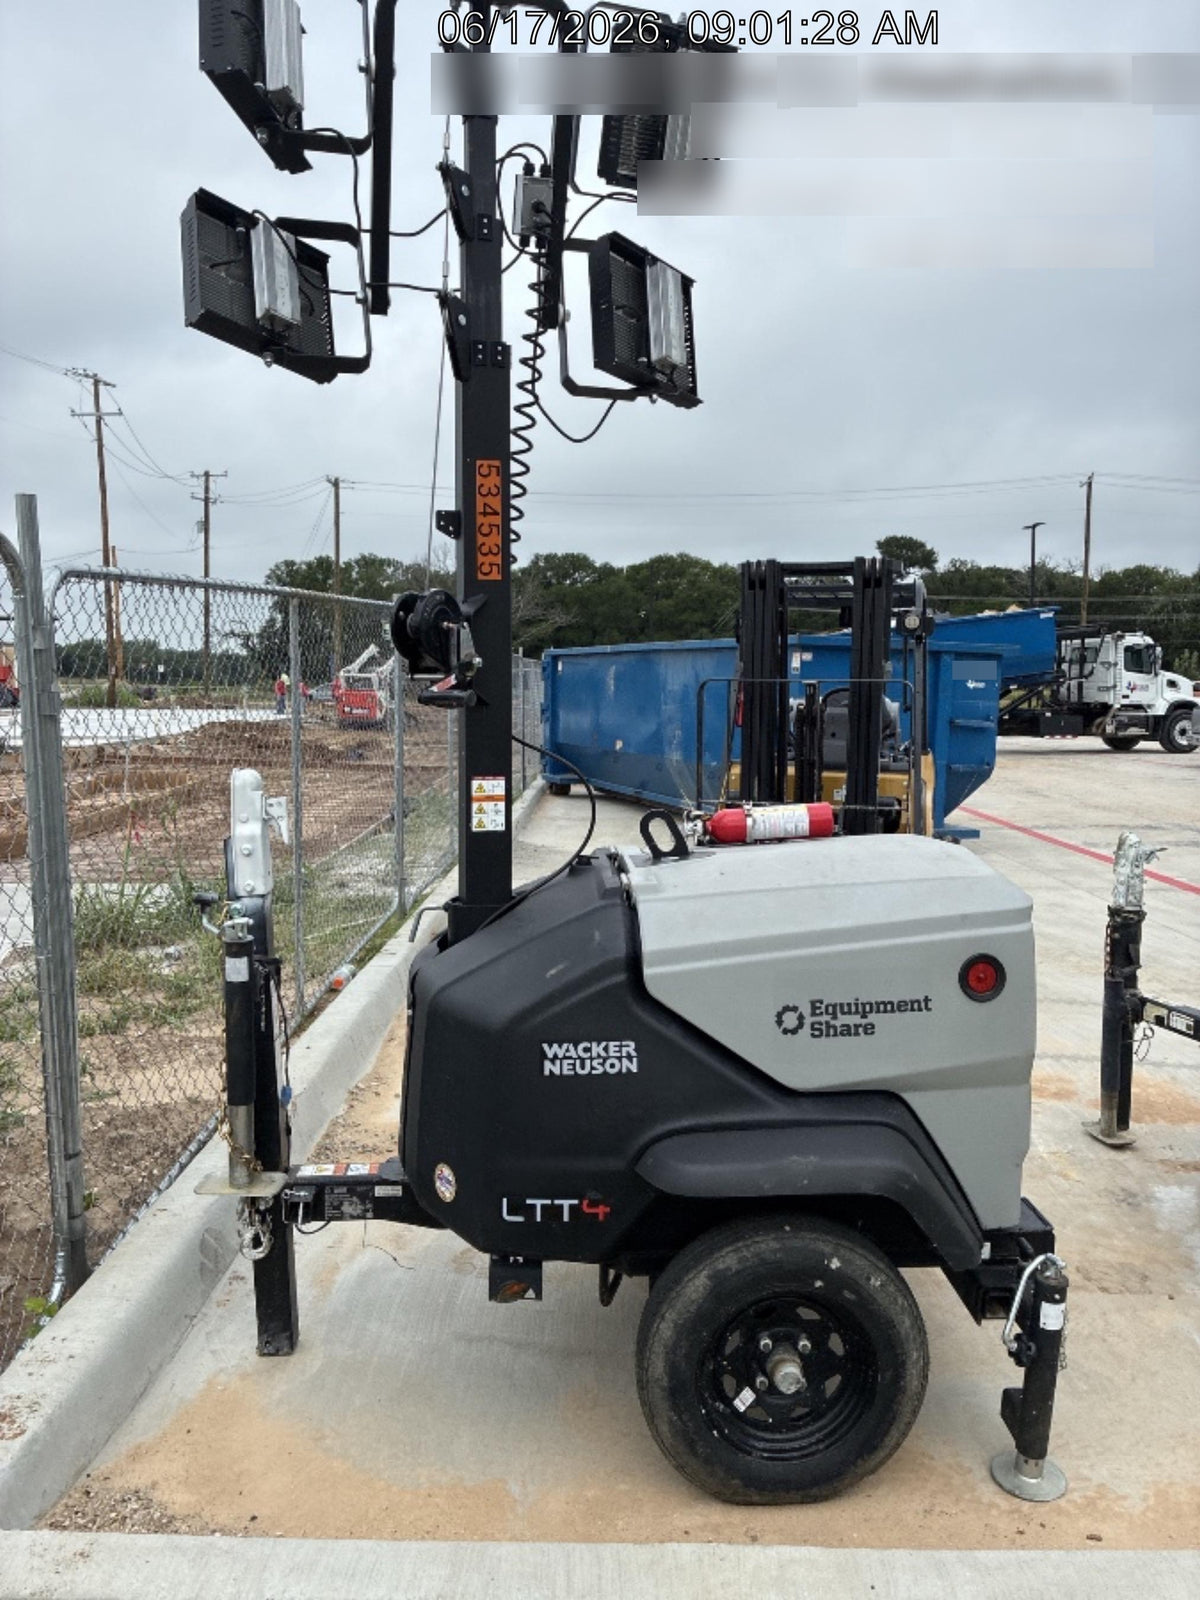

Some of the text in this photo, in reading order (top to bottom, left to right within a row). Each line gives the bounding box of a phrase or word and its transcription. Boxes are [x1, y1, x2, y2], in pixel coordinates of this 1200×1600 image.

[477, 463, 500, 577] 534535
[809, 995, 933, 1020] Equipment
[810, 1020, 876, 1039] Share
[541, 1041, 638, 1059] WACKER
[543, 1057, 638, 1076] NEUSON
[502, 1198, 610, 1222] LTT4
